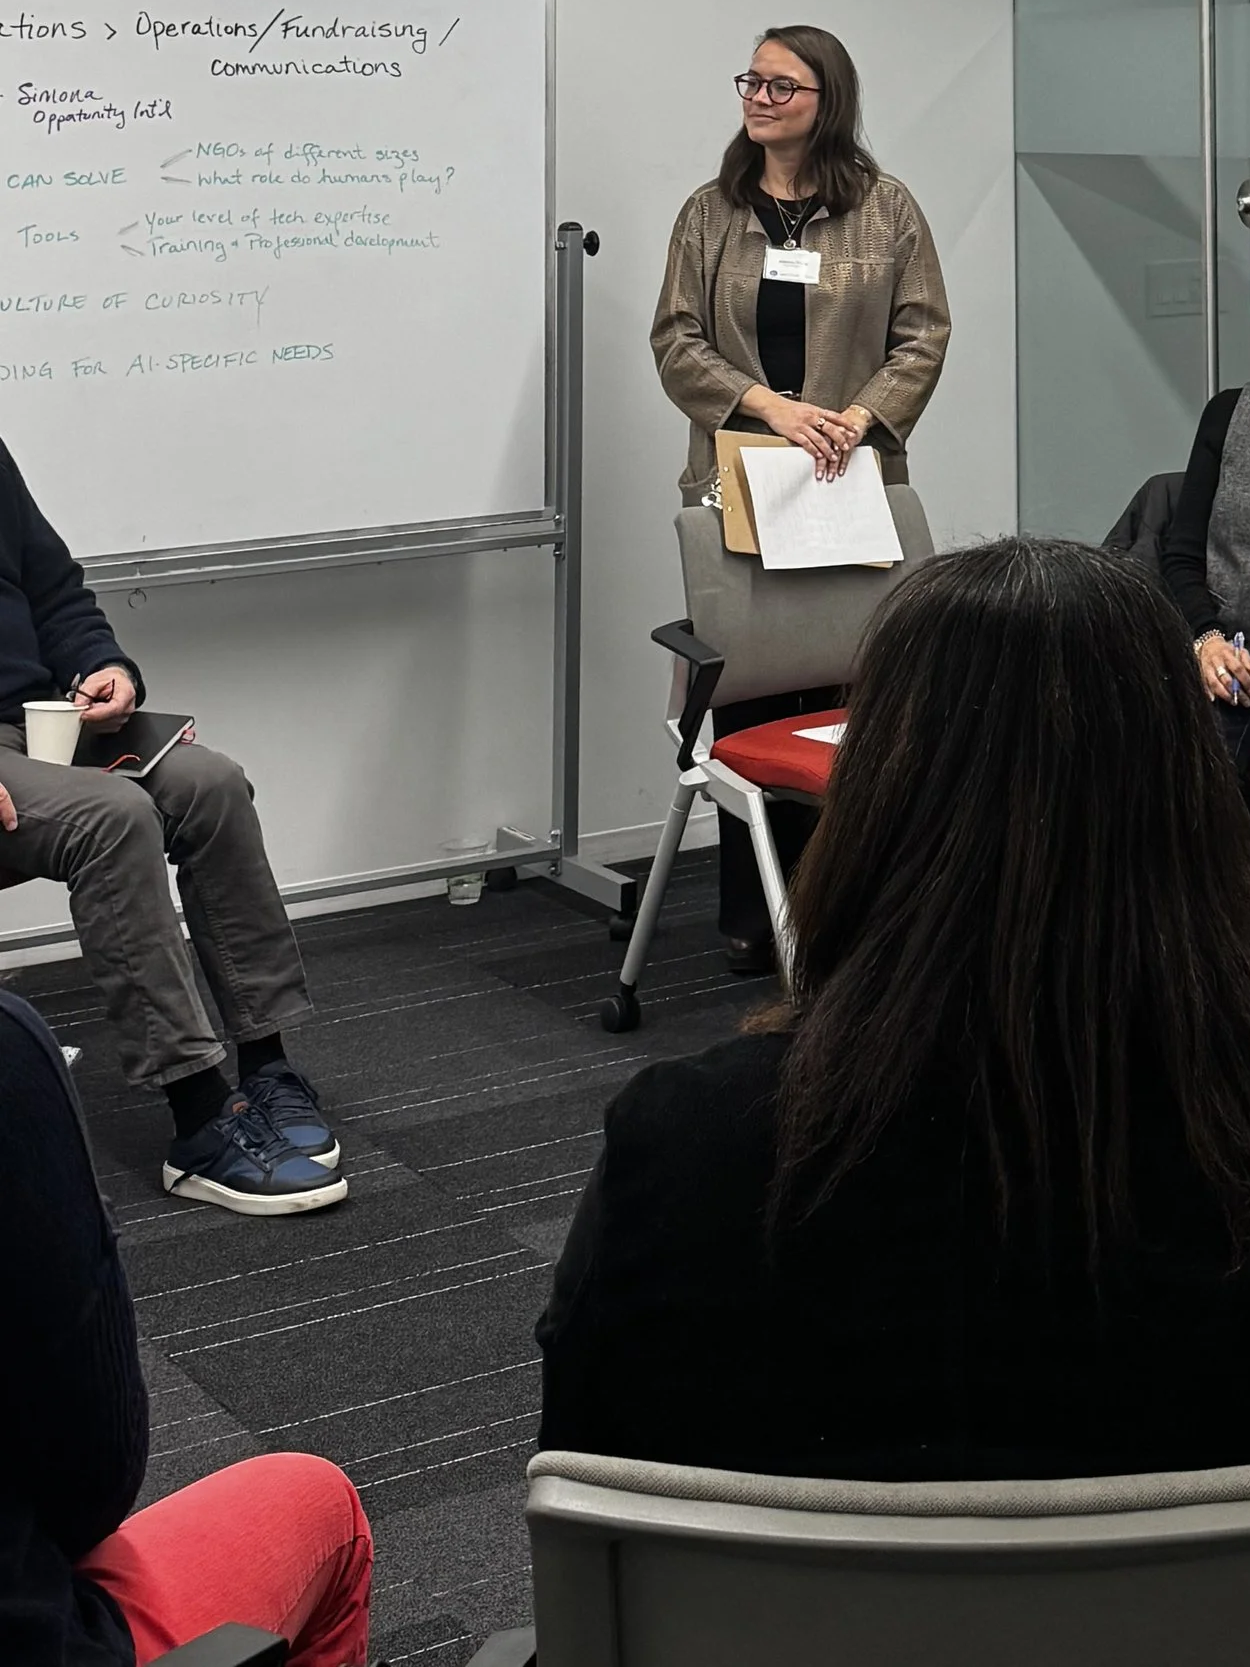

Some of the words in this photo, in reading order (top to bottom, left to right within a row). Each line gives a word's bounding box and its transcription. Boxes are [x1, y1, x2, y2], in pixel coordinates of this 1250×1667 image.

[196, 142, 246, 158] NGOs
[284, 143, 366, 167] different
[376, 147, 420, 168] sizes
[7, 173, 53, 190] CAN
[63, 167, 127, 186] SOLVE
[251, 170, 285, 184] role
[290, 168, 311, 184] do
[318, 168, 393, 185] humans
[399, 166, 456, 194] play?
[192, 210, 232, 225] level
[240, 206, 260, 226] of
[269, 206, 304, 224] tech
[314, 204, 391, 235] expertise
[147, 235, 227, 262] Training
[0, 292, 88, 312] ULTURE
[102, 291, 129, 310] OF
[145, 285, 270, 326] CURIOSITY
[272, 343, 335, 364] NEEDS
